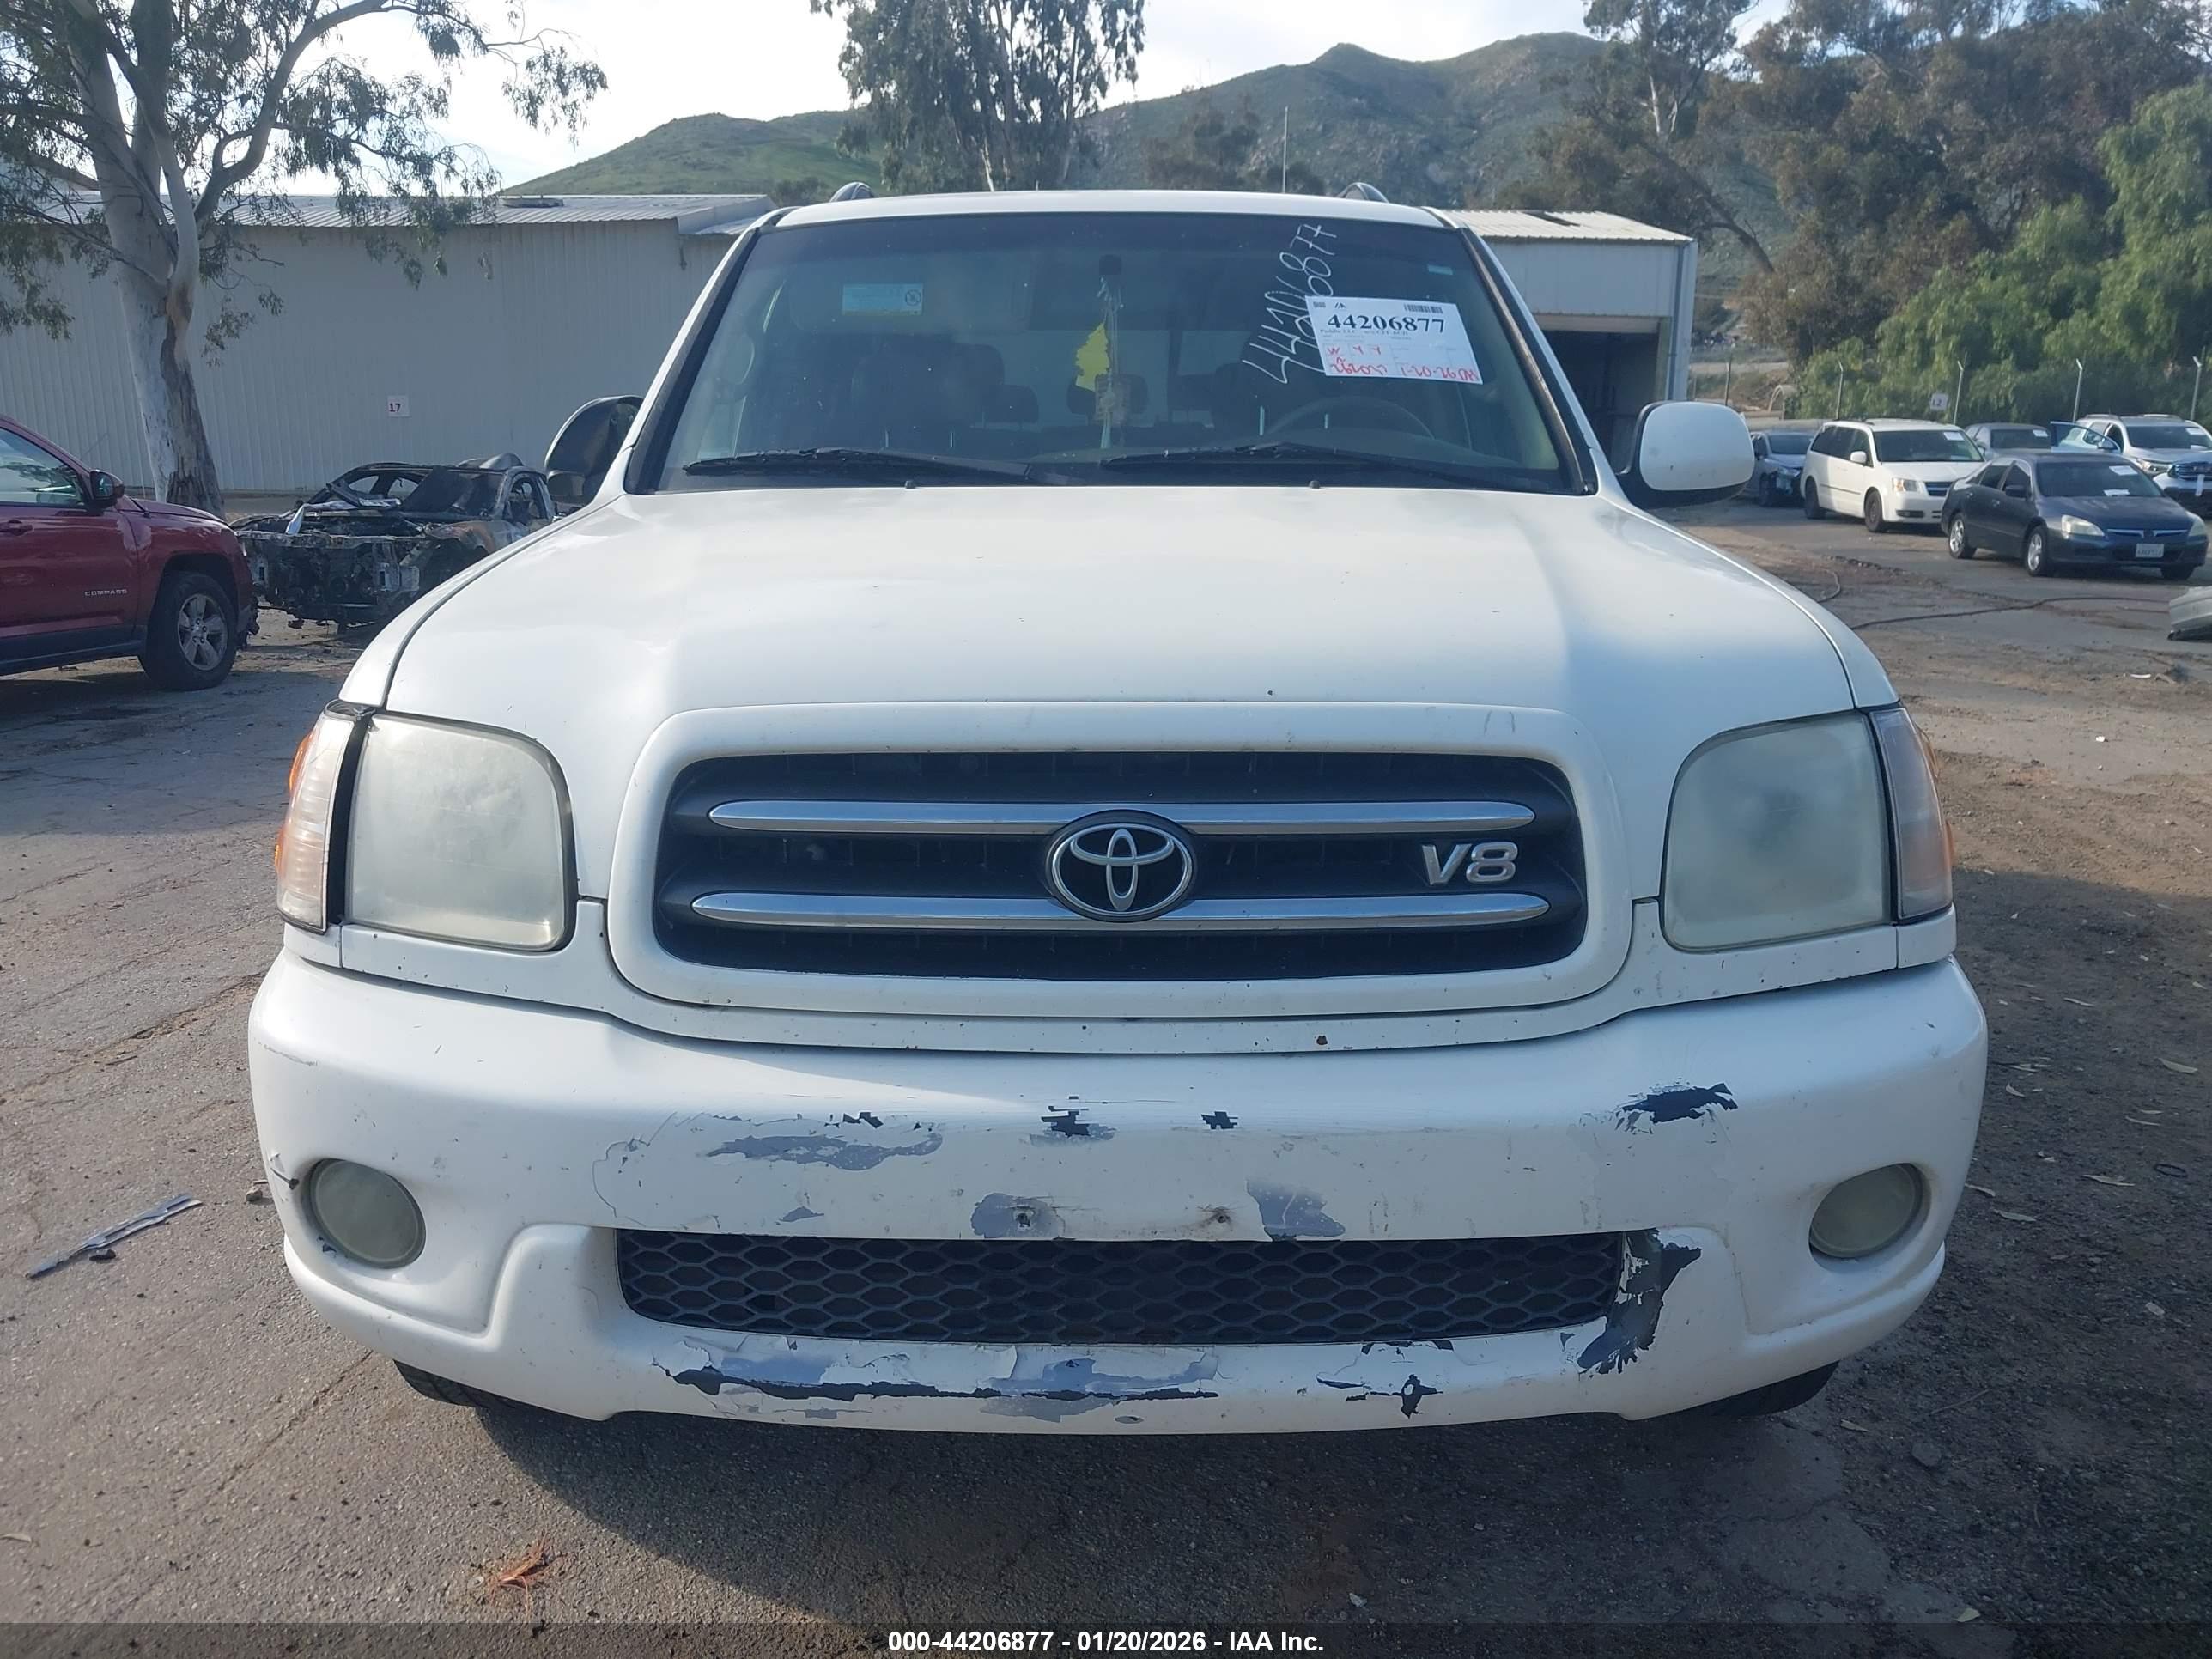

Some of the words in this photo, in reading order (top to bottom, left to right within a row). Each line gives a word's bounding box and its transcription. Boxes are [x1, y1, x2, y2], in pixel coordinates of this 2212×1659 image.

[1328, 314, 1444, 333] 44206877
[389, 403, 401, 413] 17
[1421, 841, 1518, 885] V8
